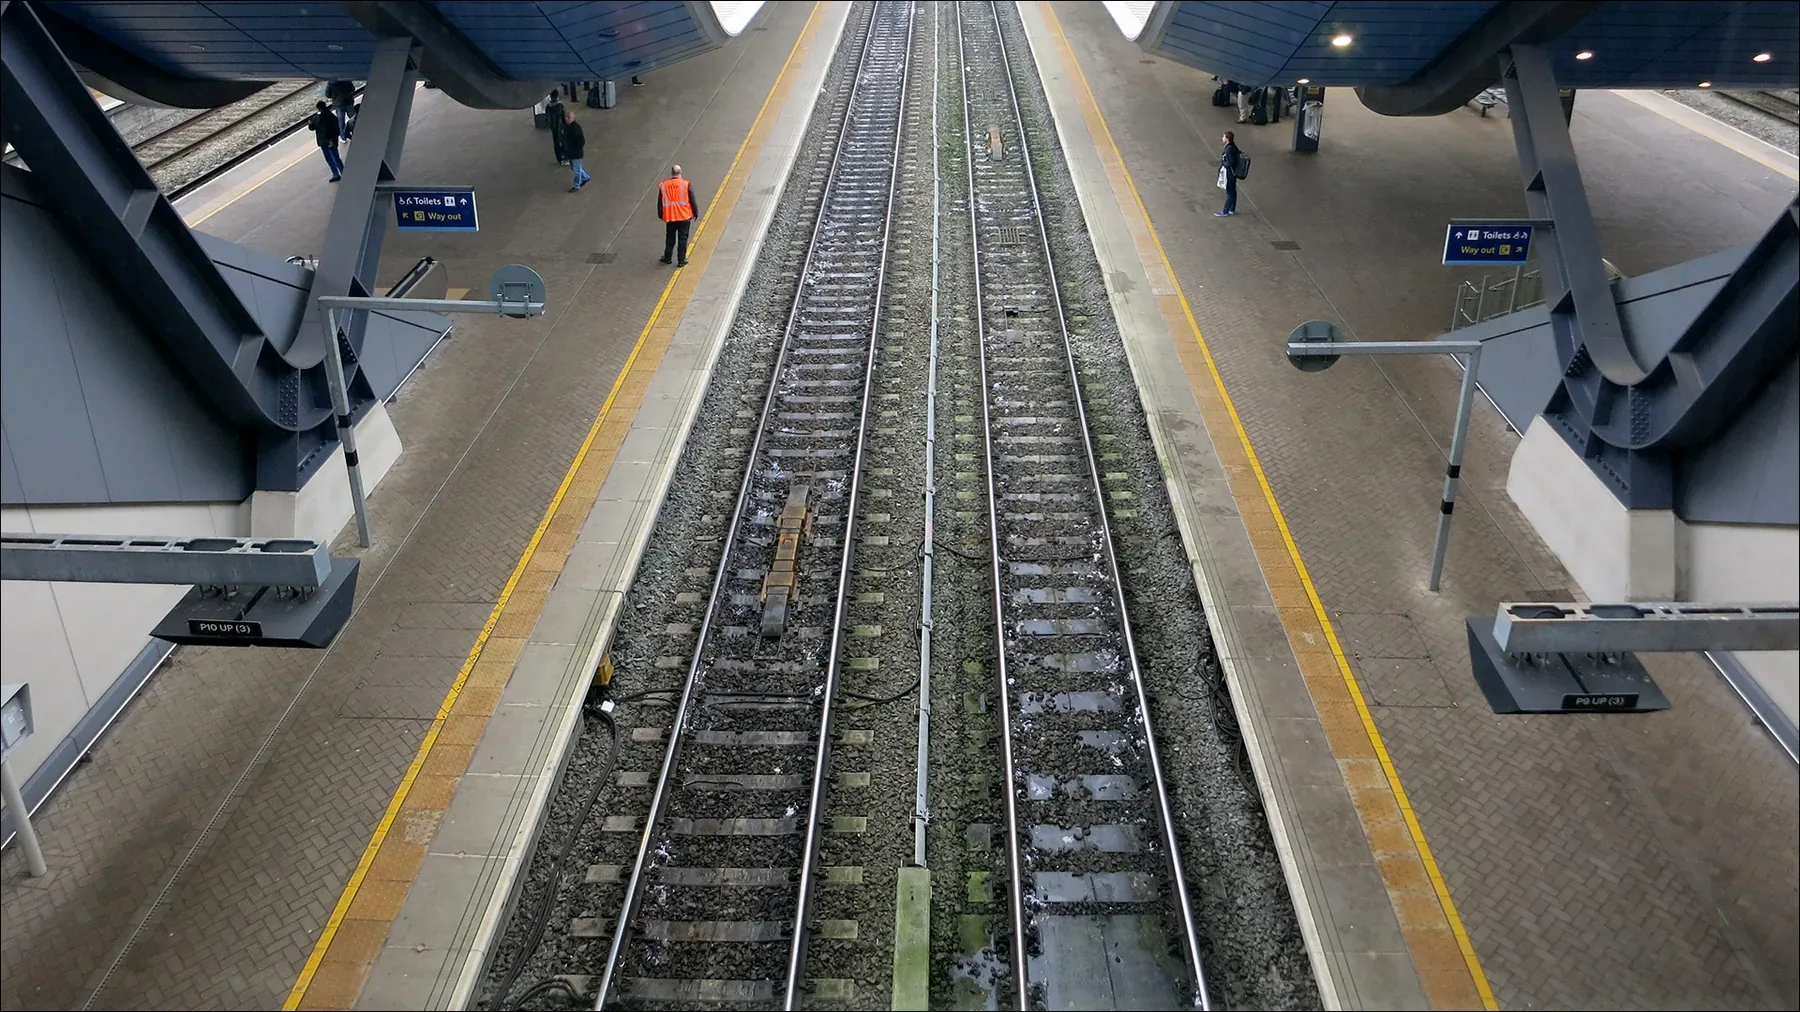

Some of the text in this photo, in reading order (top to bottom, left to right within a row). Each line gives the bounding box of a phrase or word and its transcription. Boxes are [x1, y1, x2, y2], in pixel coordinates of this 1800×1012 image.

[413, 197, 442, 206] Toilets
[427, 212, 462, 222] Way out
[1483, 231, 1511, 240] Toilets
[1461, 245, 1496, 255] Way out
[200, 623, 251, 634] P10 UP (3)
[1575, 696, 1625, 706] P9 UP (3)
